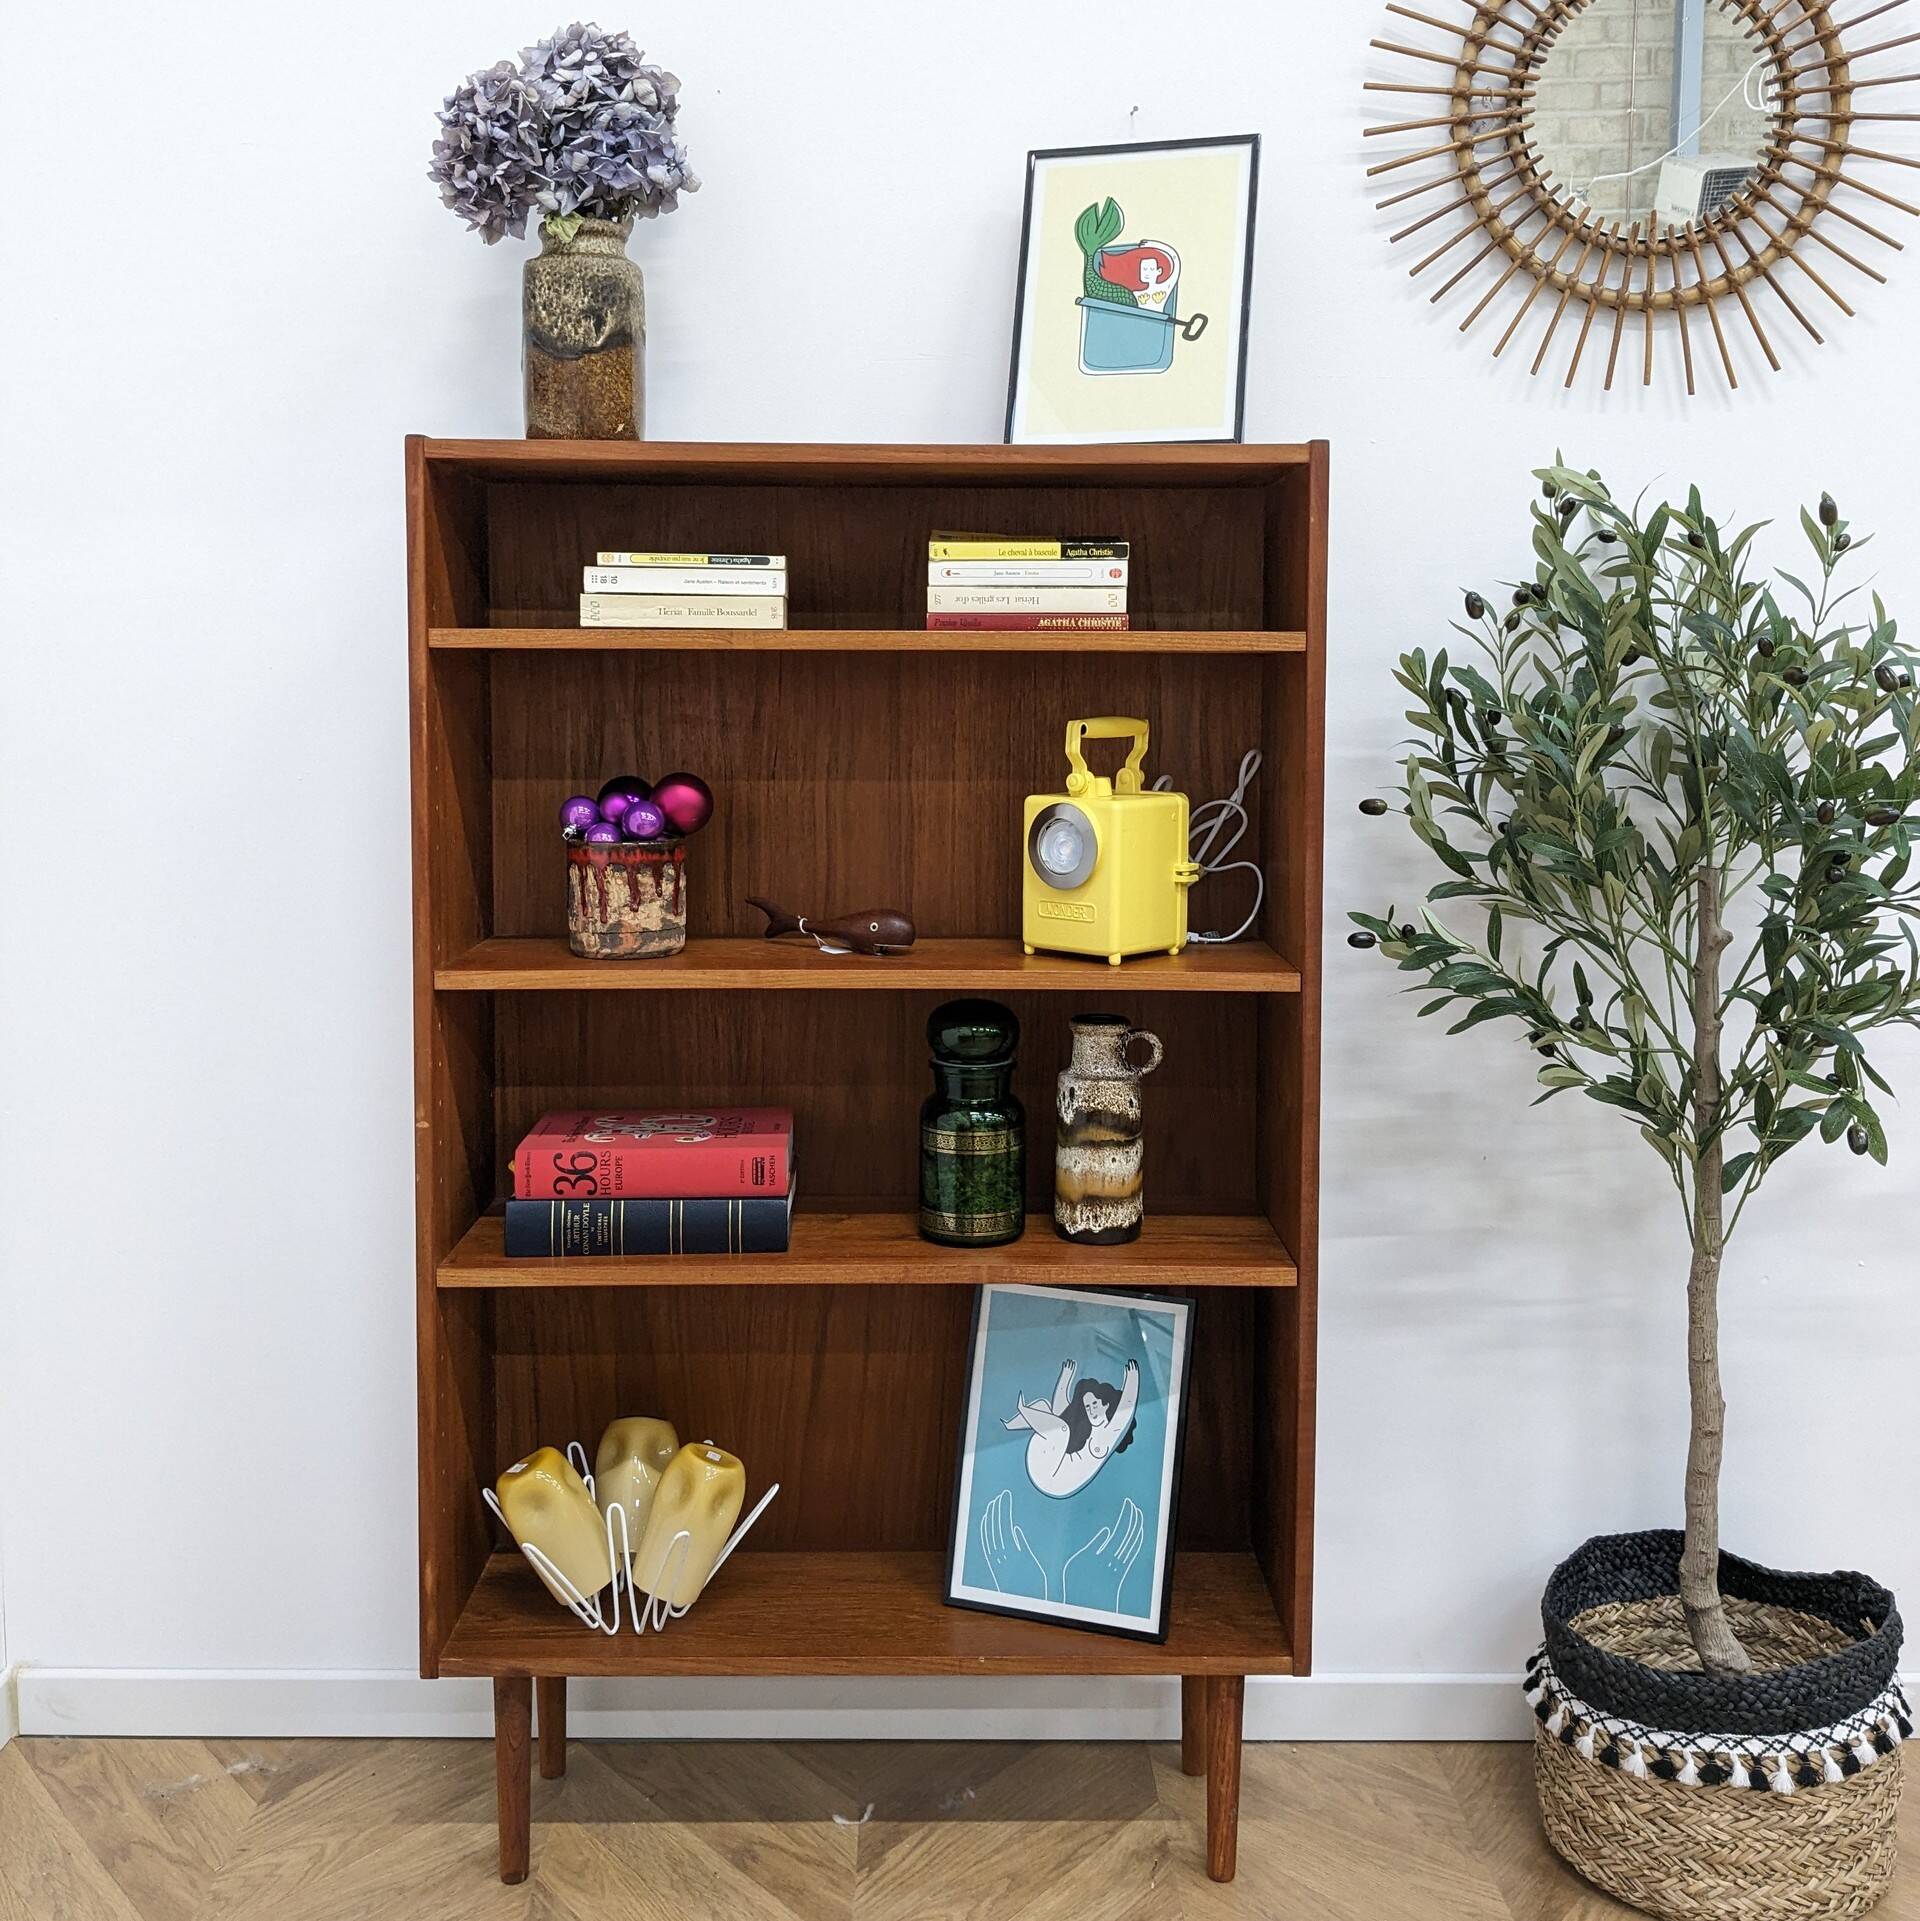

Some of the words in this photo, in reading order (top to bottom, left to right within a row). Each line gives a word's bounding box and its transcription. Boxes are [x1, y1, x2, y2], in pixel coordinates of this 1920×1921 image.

[998, 548, 1006, 556] Le
[1007, 548, 1028, 556] cheval
[1034, 548, 1057, 556] bascule
[1066, 548, 1087, 557] Agatha
[1088, 548, 1113, 556] Christie
[599, 575, 608, 585] 18
[610, 575, 618, 585] 10
[971, 595, 994, 605] grilles
[996, 596, 1010, 605] Les
[687, 607, 715, 616] Famille
[716, 607, 758, 617] Boussardel
[1038, 618, 1076, 628] AGATHA
[1077, 617, 1122, 628] CHRISTIE
[1045, 902, 1089, 919] WONDER
[552, 1151, 598, 1196] 36
[600, 1150, 611, 1195] HOURS
[615, 1155, 623, 1191] EUROPE
[768, 1155, 776, 1186] TASCHEN
[582, 1202, 590, 1229] DOYLE
[582, 1229, 590, 1255] CONAN
